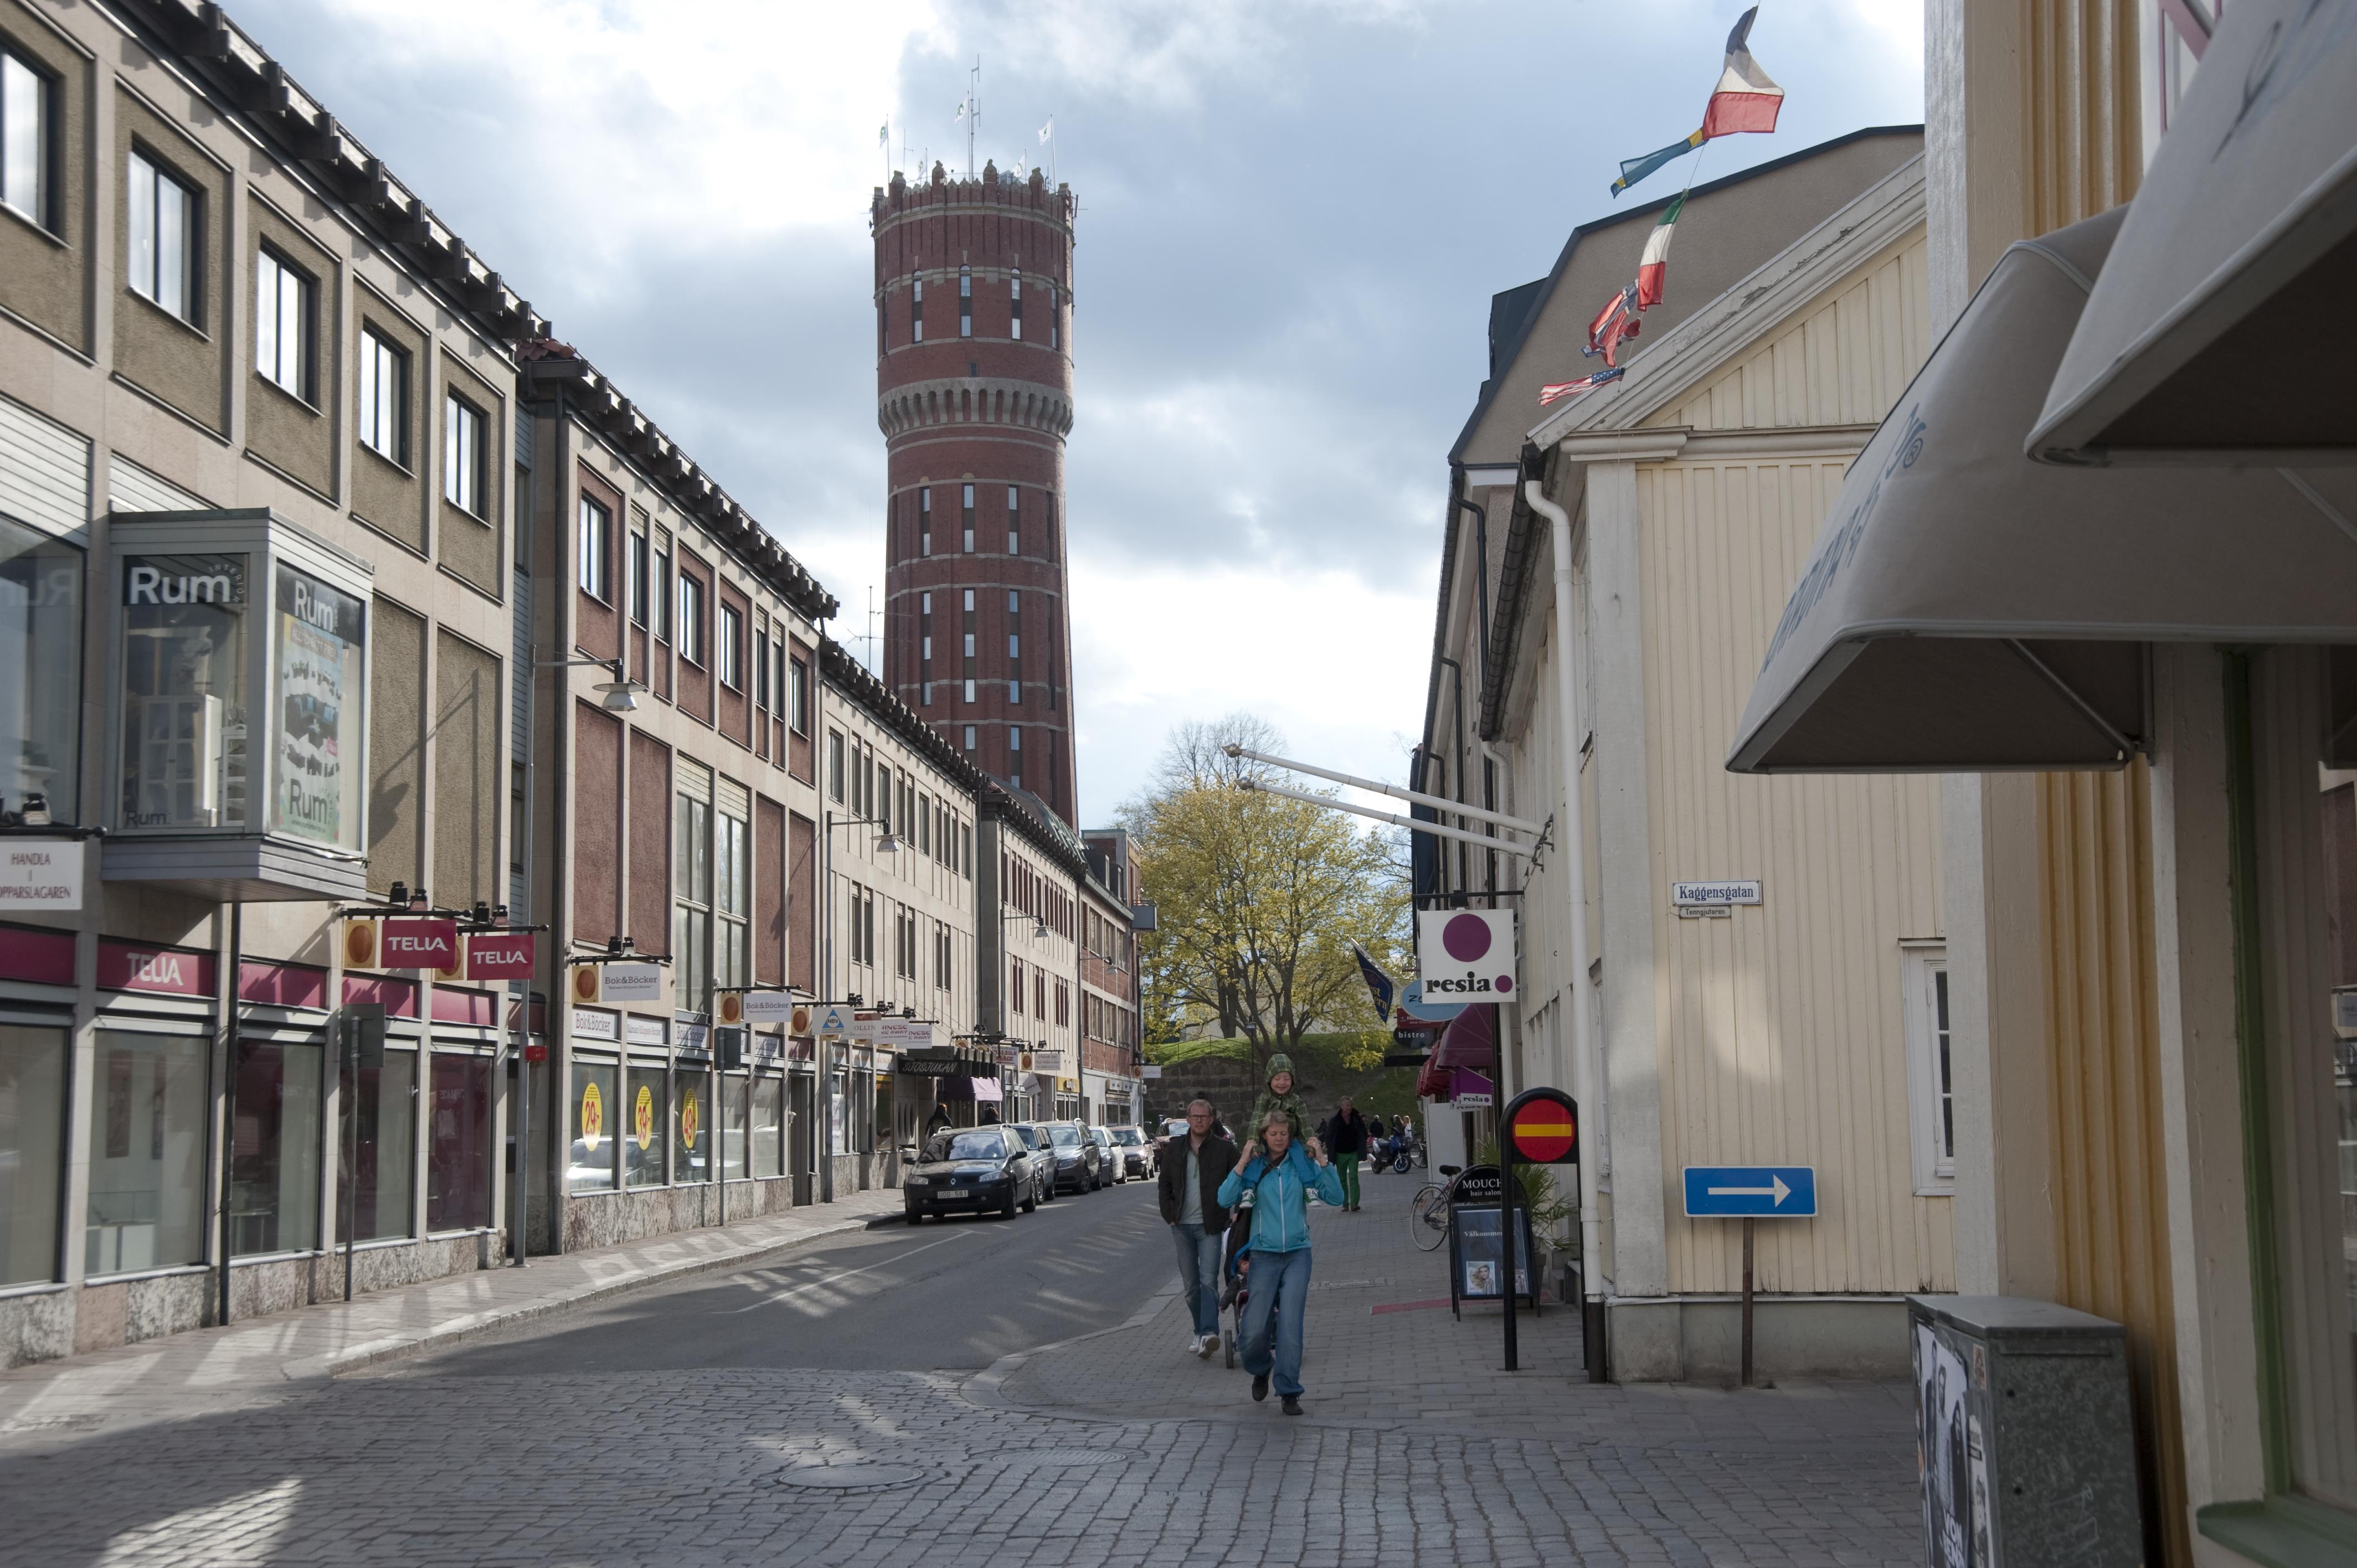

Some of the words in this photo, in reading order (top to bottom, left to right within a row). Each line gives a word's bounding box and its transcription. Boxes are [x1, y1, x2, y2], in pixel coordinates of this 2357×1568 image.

[130, 566, 230, 605] Rum
[208, 564, 245, 602] INTERIOR
[295, 580, 334, 633] Rum
[289, 778, 327, 824] Rum
[124, 810, 167, 828] Rum
[11, 852, 51, 865] HANDLA
[1679, 884, 1754, 901] Kaggensgatan
[1685, 907, 1725, 916] Tenngjutaren
[387, 936, 449, 951] TELIA
[472, 950, 529, 964] TELIA
[126, 952, 184, 986] TELIA
[604, 976, 658, 984] Bok&Böcker
[1425, 971, 1492, 993] resia
[575, 1013, 611, 1033] Bok&Böcker
[1463, 1179, 1502, 1189] MOUCH
[1943, 1506, 1963, 1553] VON
